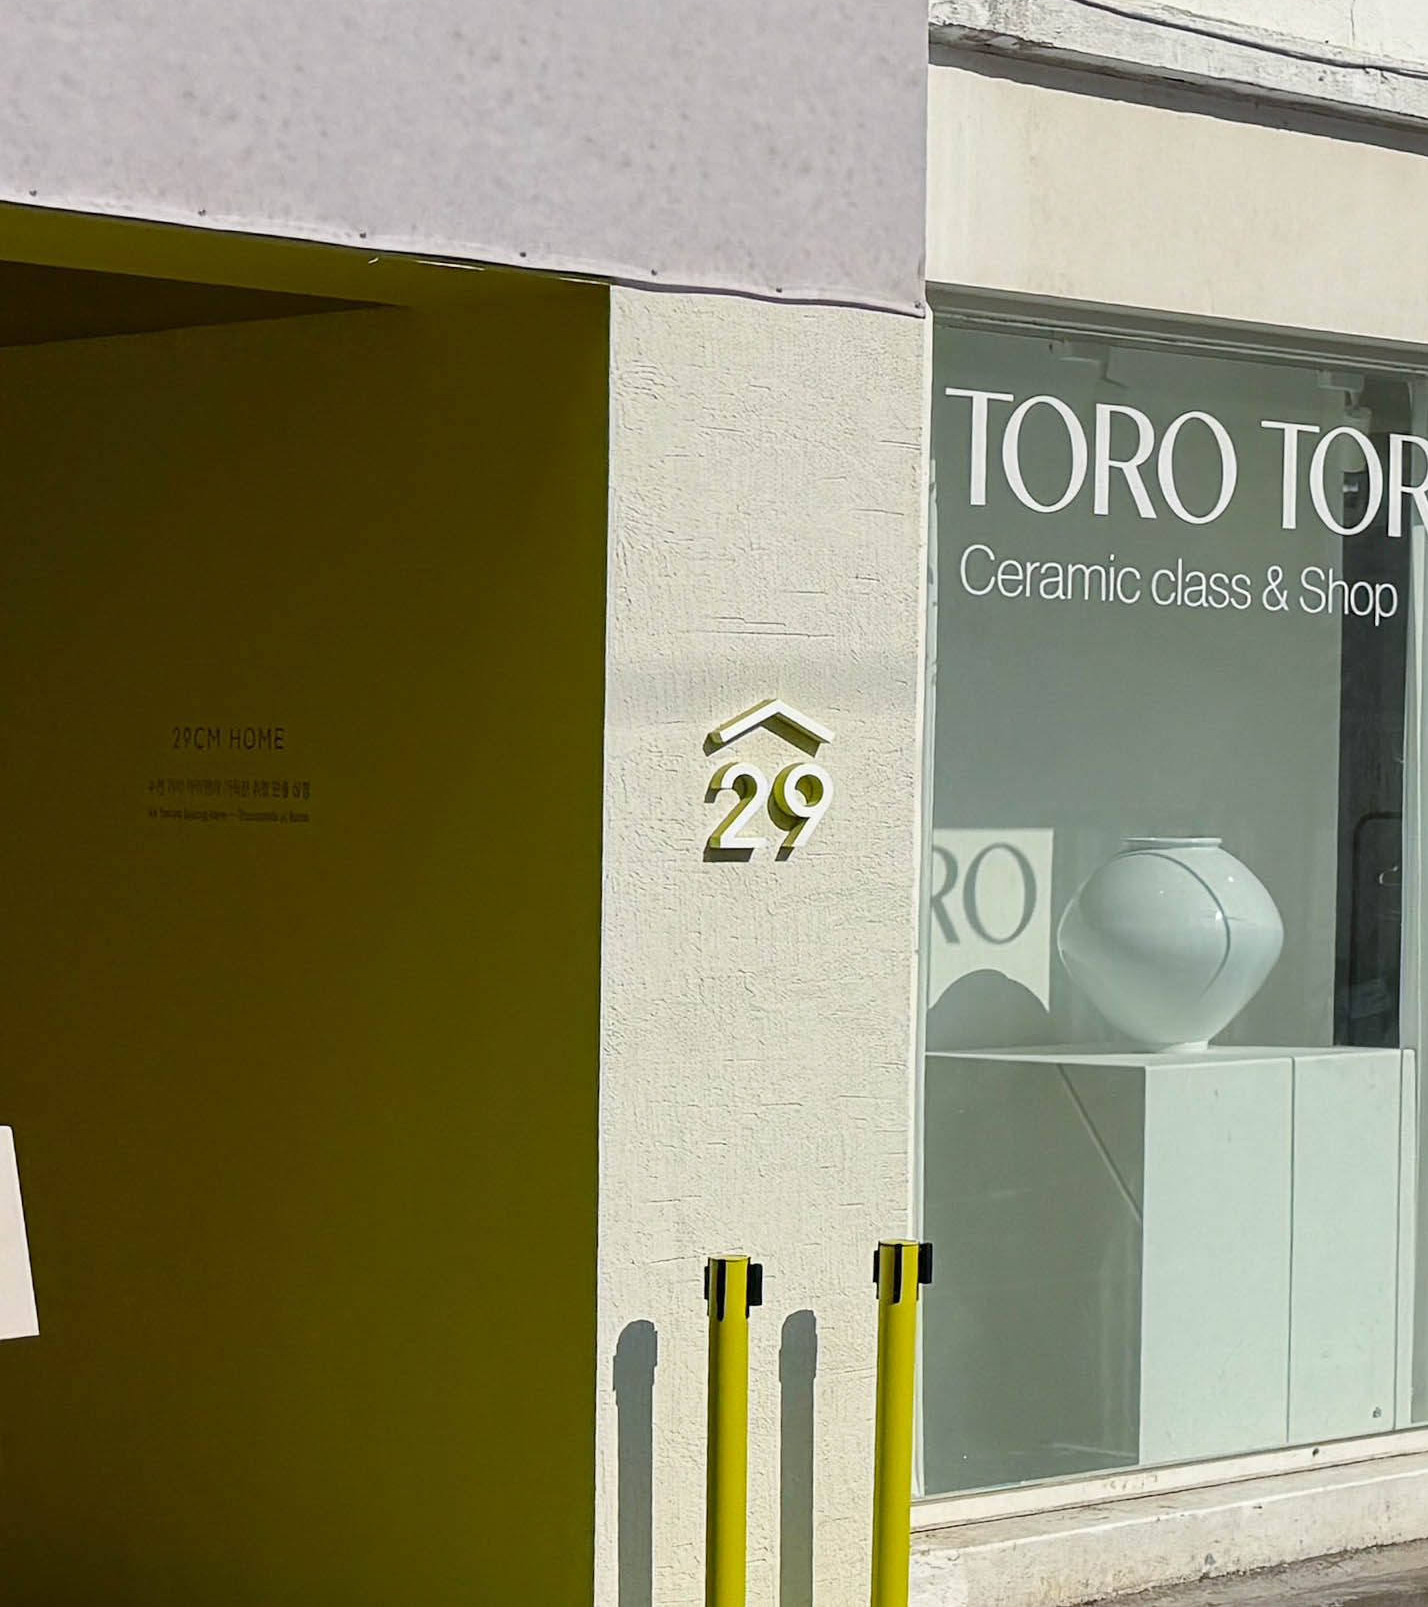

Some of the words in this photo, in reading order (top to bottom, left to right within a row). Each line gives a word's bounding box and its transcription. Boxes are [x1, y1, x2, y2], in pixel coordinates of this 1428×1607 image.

[945, 387, 1238, 525] TORO
[960, 544, 1141, 605] Ceramic
[1151, 557, 1252, 610] class
[1262, 566, 1289, 612] &
[1299, 568, 1399, 626] Shop
[172, 726, 220, 750] 29CM
[230, 726, 287, 750] HOME
[704, 761, 834, 861] 29
